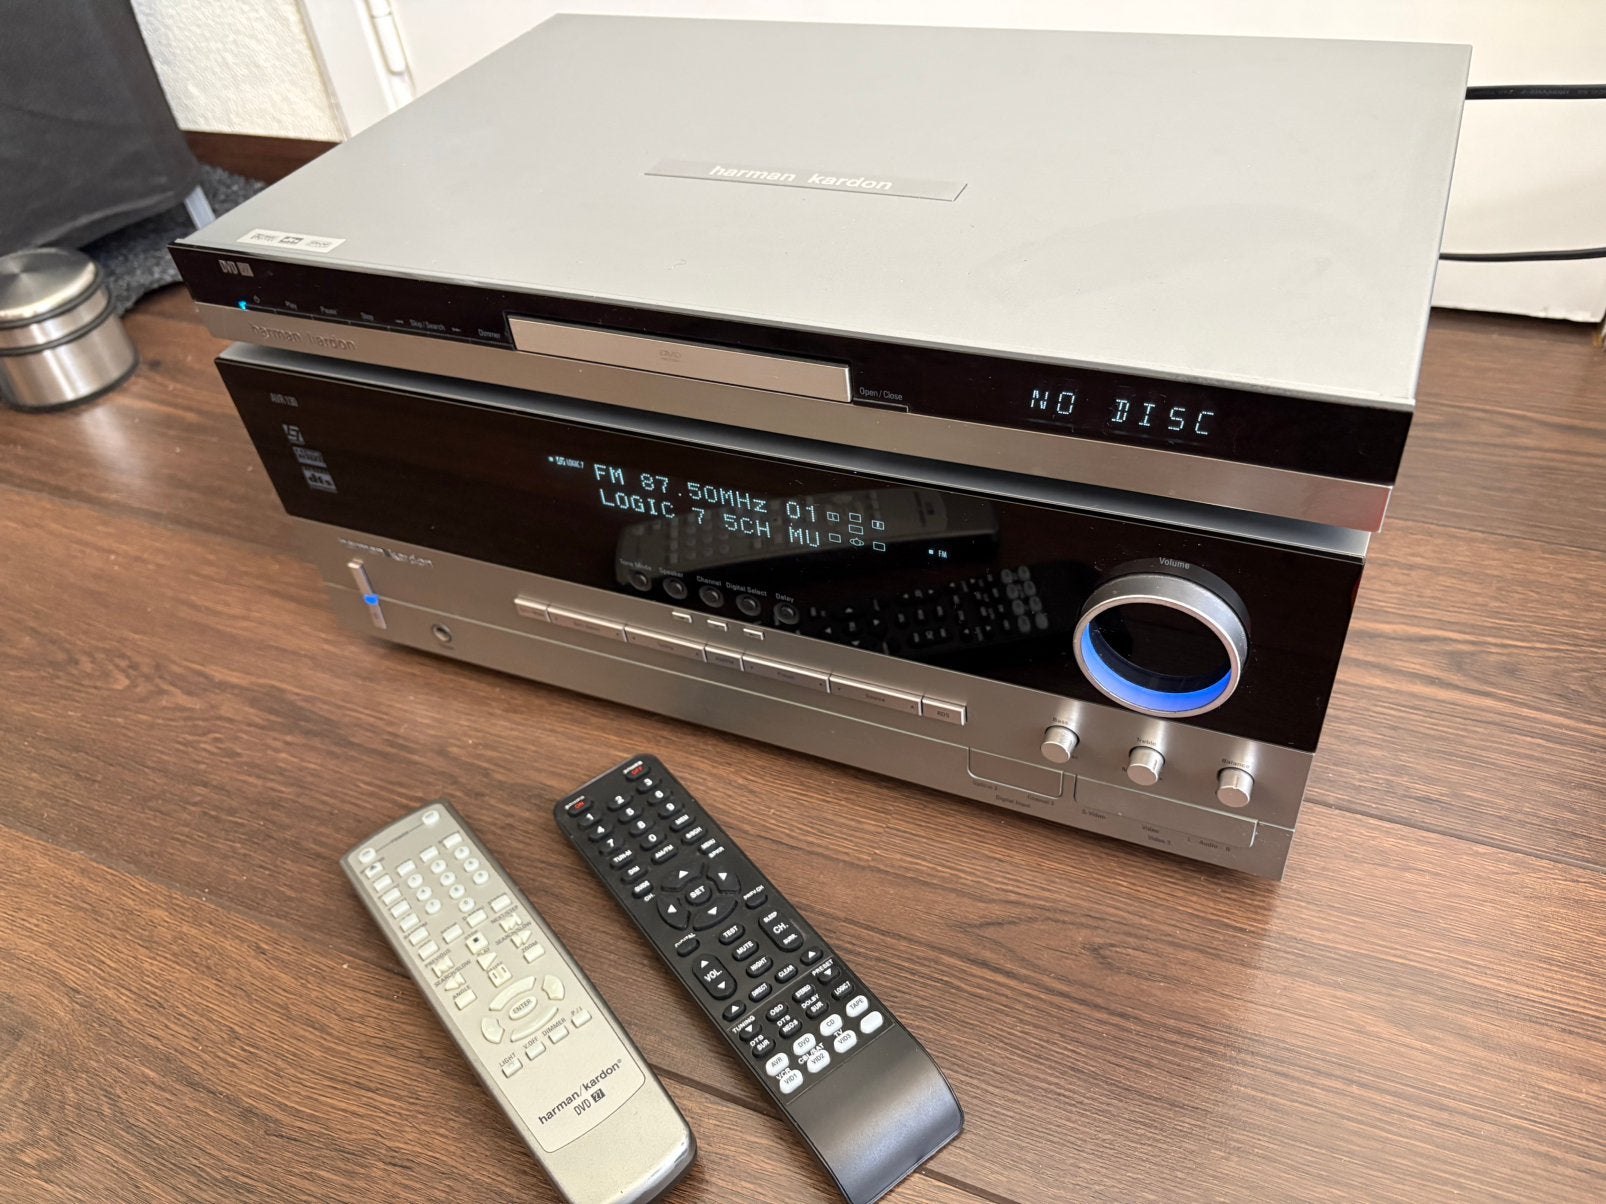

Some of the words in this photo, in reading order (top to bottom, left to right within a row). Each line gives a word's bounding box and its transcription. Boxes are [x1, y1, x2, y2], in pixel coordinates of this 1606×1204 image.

[709, 165, 796, 182] harman
[808, 172, 892, 191] kardon
[218, 260, 238, 274] DVD
[1030, 390, 1075, 415] NO
[1111, 398, 1214, 435] DISC
[594, 463, 624, 485] FM
[786, 501, 815, 522] 01
[600, 488, 675, 518] LOGIC
[692, 507, 704, 524] 7
[724, 513, 770, 538] 5CH
[788, 526, 819, 547] MU
[938, 549, 947, 558] FM
[1159, 556, 1190, 570] Volume
[659, 567, 683, 578] Speaker
[696, 576, 722, 586] Channel
[726, 582, 746, 593] Digital
[747, 586, 767, 597] Select
[776, 593, 794, 603] Delay
[1221, 758, 1250, 769] Balance
[644, 778, 653, 786] 3
[615, 795, 624, 804] 2
[654, 790, 664, 799] 6
[625, 807, 635, 816] 5
[666, 802, 675, 811] 9
[597, 825, 605, 833] 4
[636, 820, 646, 829] 8
[606, 838, 614, 847] 7
[648, 833, 657, 842] 0
[627, 865, 640, 876] DIM
[689, 885, 705, 899] SET
[763, 911, 778, 923] SLEEP
[722, 925, 738, 939] TEST
[772, 921, 789, 934] CH.
[521, 940, 538, 952] ZOOM
[736, 940, 754, 955] MUTE
[750, 956, 767, 972] NIGHT
[811, 959, 834, 977] PRESET
[704, 968, 723, 982] VOL.
[777, 964, 794, 978] CLEAR
[452, 985, 471, 1000] ANGLE
[751, 982, 768, 997] DIRECT
[794, 984, 811, 998] STEREO
[512, 998, 532, 1014] ENTER
[800, 993, 819, 1009] DOLBY
[810, 1001, 824, 1013] SUR
[849, 998, 864, 1010] TAPE
[769, 1003, 784, 1016] OSD
[542, 1017, 567, 1037] DIMMER
[732, 1015, 755, 1034] TUNING
[776, 1014, 791, 1027] DTS
[825, 1018, 835, 1028] CD
[833, 1028, 843, 1038] TV
[838, 1033, 852, 1045] VID3
[749, 1034, 764, 1047] DTS
[756, 1039, 770, 1051] SUR
[797, 1036, 810, 1048] DVD
[797, 1042, 825, 1064] CBL/SAT
[811, 1052, 825, 1065] VID2
[499, 1052, 517, 1068] LIGHT
[771, 1056, 783, 1068] AVR
[775, 1067, 792, 1080] VCR
[784, 1073, 798, 1085] VID1
[573, 1098, 592, 1116] DVD
